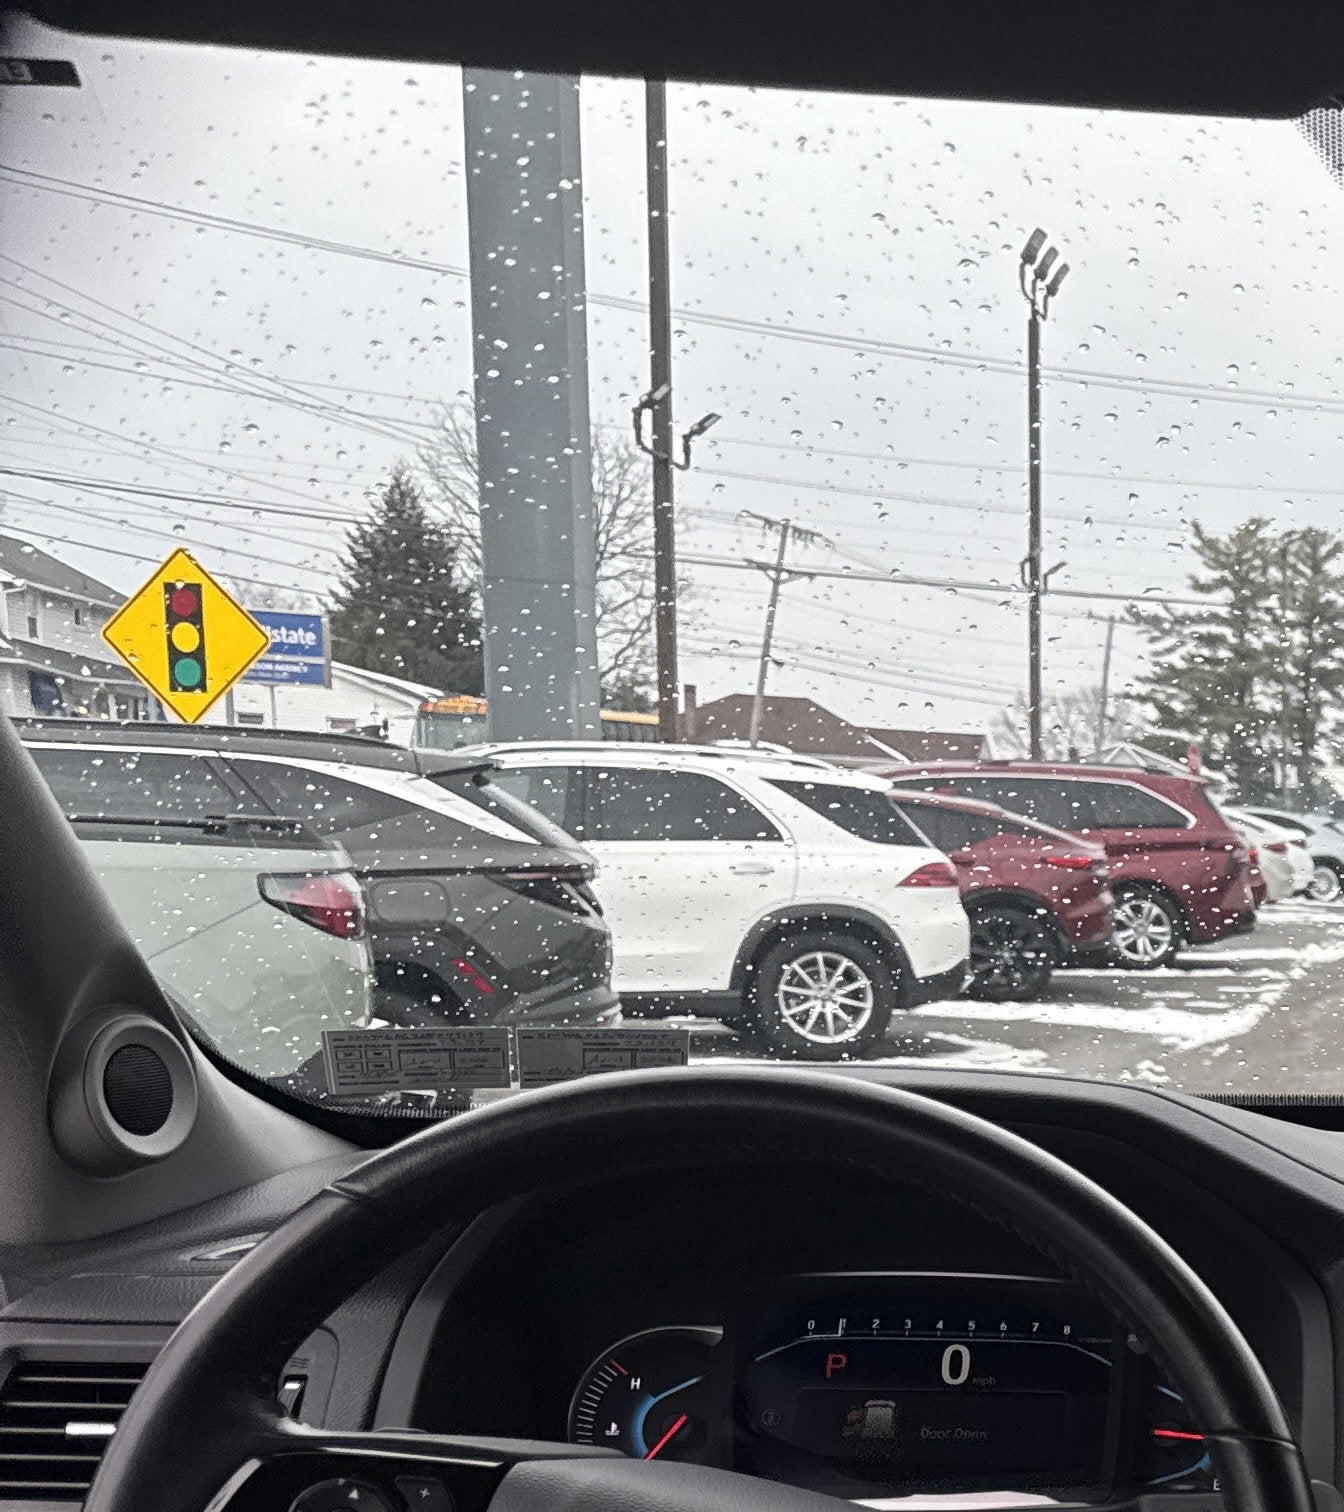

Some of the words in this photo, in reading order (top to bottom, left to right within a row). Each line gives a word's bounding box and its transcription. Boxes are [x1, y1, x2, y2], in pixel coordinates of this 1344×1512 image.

[872, 1318, 880, 1329] 2
[904, 1319, 912, 1329] 3
[936, 1319, 943, 1330] 4
[968, 1320, 975, 1331] 5
[1000, 1320, 1007, 1331] 6
[1032, 1322, 1039, 1332] 7
[1063, 1324, 1070, 1335] 8
[824, 1352, 848, 1379] P
[940, 1343, 971, 1387] 0
[630, 1377, 641, 1391] H
[1213, 1478, 1221, 1491] E
